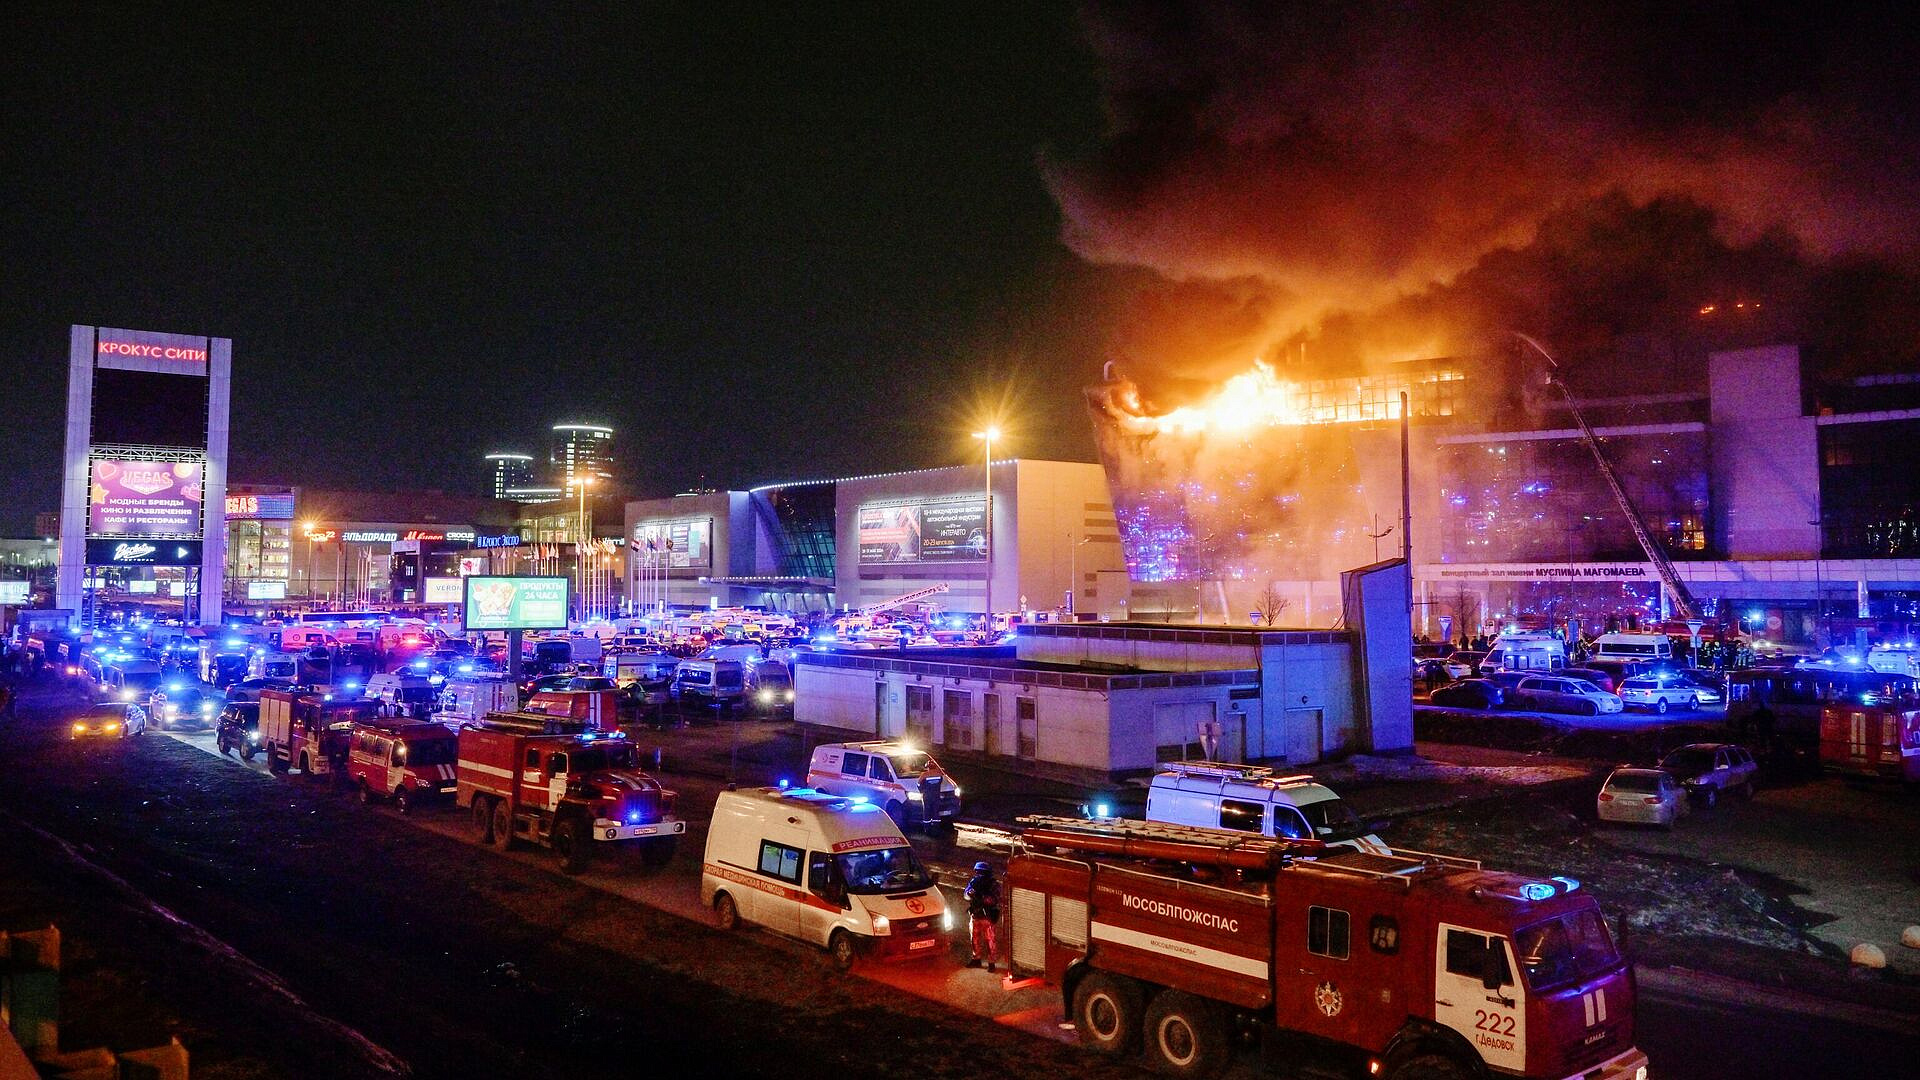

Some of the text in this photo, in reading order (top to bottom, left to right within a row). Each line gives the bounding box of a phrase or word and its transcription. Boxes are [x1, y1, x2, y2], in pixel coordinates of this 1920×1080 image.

[99, 342, 206, 361] КРОКУС СИТИ
[123, 470, 171, 485] VEGAS
[148, 499, 184, 507] БРЕНДЫ
[225, 497, 258, 513] EGAS
[342, 532, 398, 542] ЭЛЬДОРАДО
[1535, 568, 1582, 577] МУСЛИМА
[1583, 568, 1646, 577] МАГОМАЕВА
[436, 584, 462, 592] VERON
[520, 582, 564, 592] ПРОДУКТЫ
[525, 591, 559, 600] 24 ЧАСА
[839, 837, 902, 849] РЕАНИМАЦИЯ
[704, 864, 785, 896] СКОРАЯ МЕДИЦИНСКАЯ ПОМОЩЬ
[1122, 893, 1239, 933] МОСОБЛПОЖСПАС
[1475, 1009, 1516, 1037] 222
